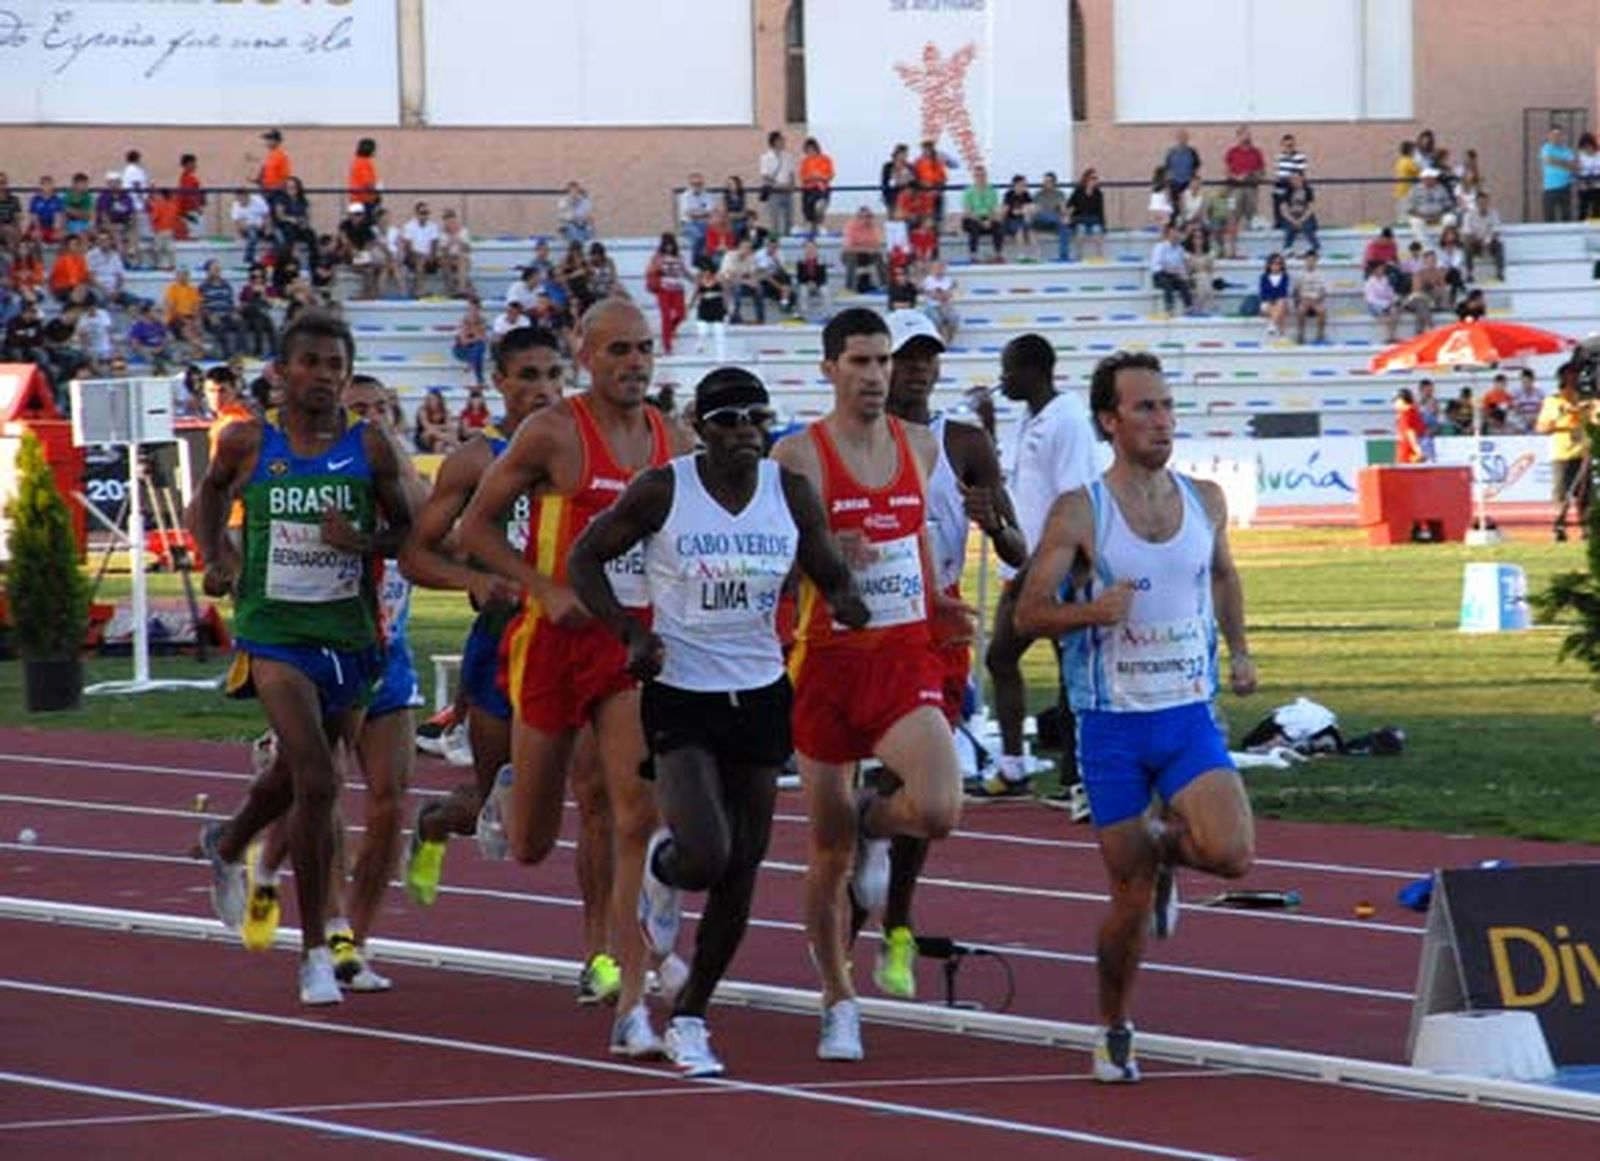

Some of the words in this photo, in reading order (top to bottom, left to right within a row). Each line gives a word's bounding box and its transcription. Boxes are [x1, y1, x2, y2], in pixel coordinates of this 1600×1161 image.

[269, 484, 355, 515] BRASIL
[676, 533, 729, 556] CABO
[734, 533, 791, 557] VERDE
[701, 581, 750, 611] LIMA
[902, 573, 920, 598] 26
